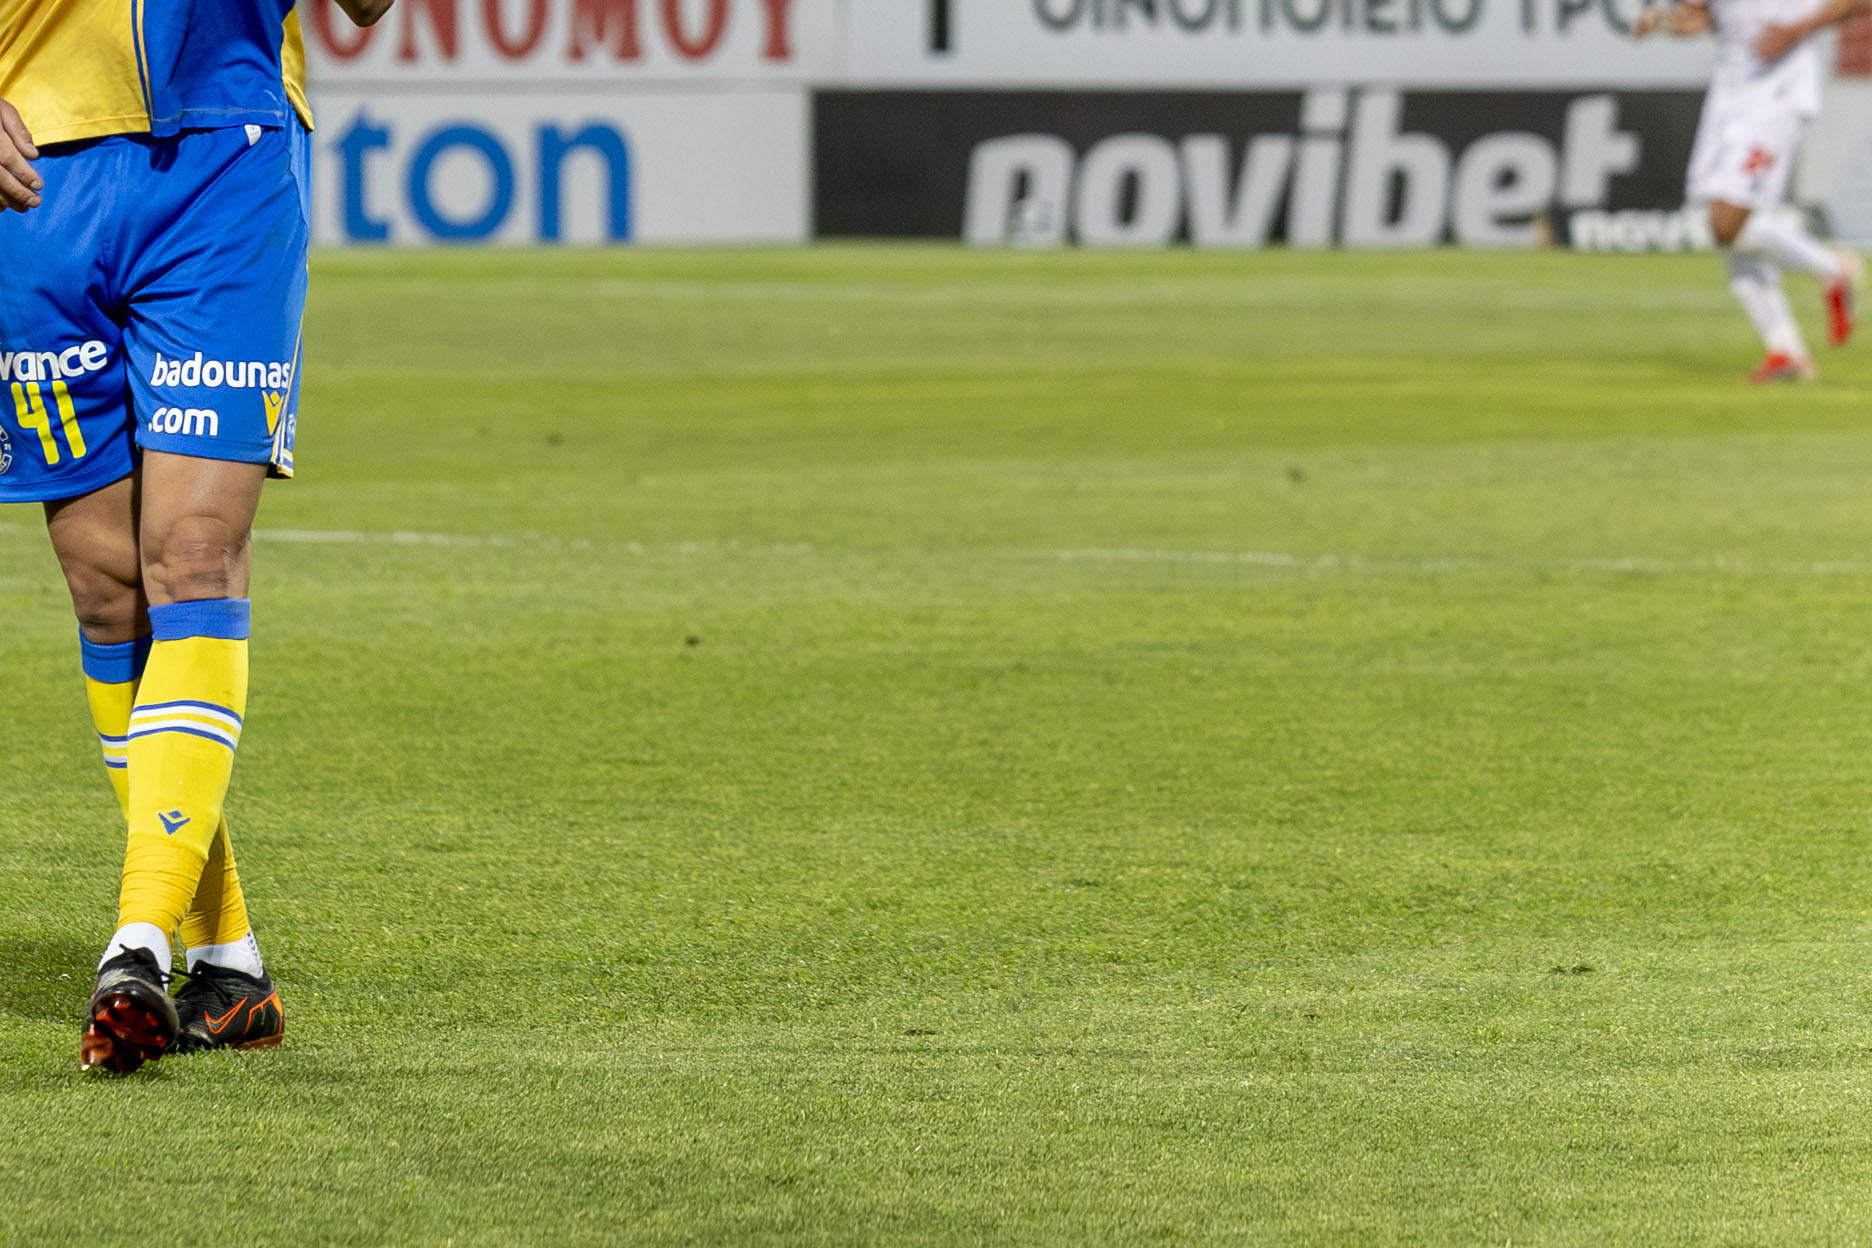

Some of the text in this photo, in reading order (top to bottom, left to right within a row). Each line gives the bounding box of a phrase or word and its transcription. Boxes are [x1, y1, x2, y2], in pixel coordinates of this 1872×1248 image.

[964, 89, 1640, 249] novibet
[151, 352, 291, 388] badounas
[11, 381, 87, 464] 41
[148, 407, 219, 437] .com
